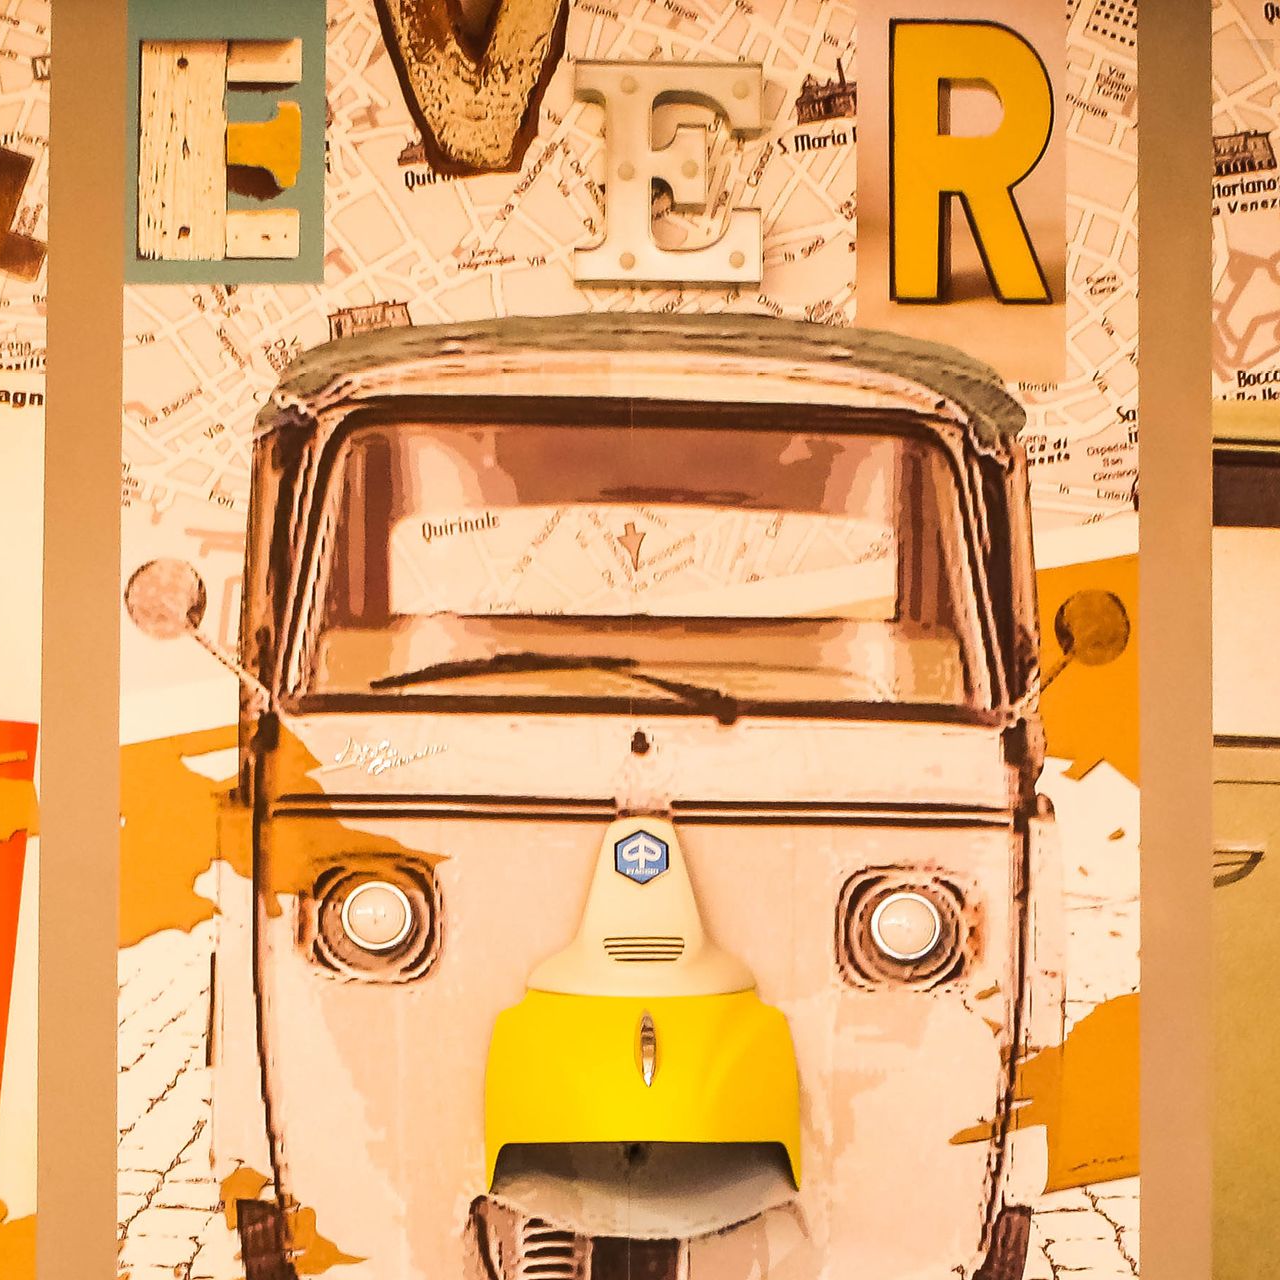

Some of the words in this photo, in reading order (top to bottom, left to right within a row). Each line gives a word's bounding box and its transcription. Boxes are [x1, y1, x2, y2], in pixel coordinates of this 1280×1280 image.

[793, 129, 847, 153] Maria
[136, 334, 156, 344] Via
[1093, 370, 1108, 394] Via
[203, 422, 226, 440] Via
[422, 511, 501, 543] Quirinale
